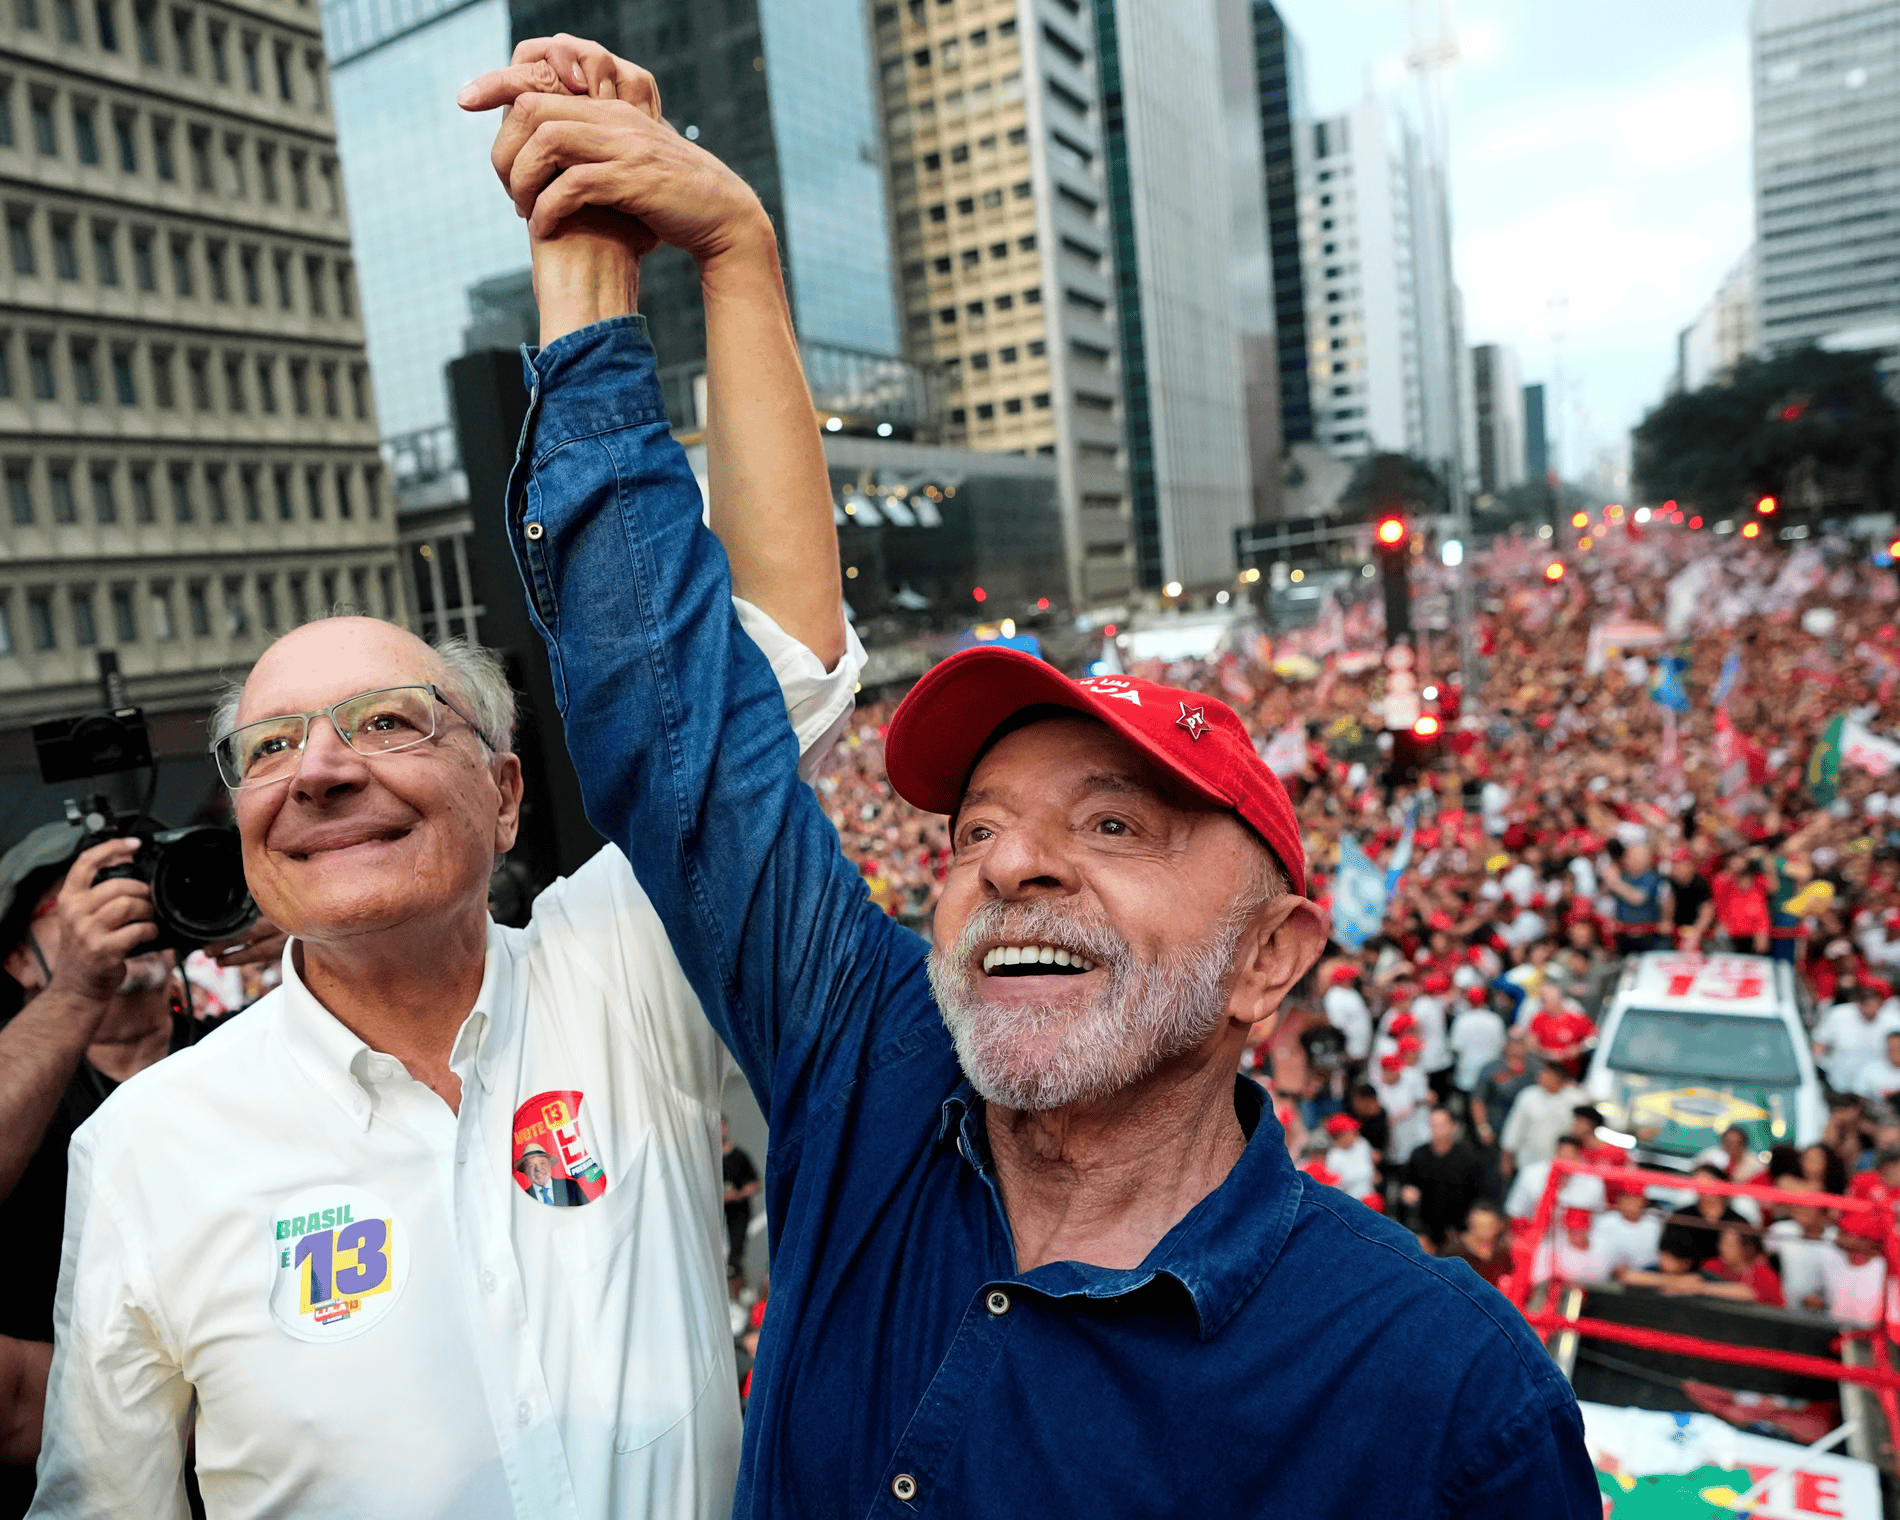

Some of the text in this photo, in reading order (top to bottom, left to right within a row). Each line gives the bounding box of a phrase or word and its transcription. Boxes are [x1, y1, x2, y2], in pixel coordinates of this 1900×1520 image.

[1186, 712, 1204, 729] PT
[544, 1103, 563, 1126] 13
[276, 1204, 354, 1241] BRASIL
[281, 1218, 388, 1306] É 13
